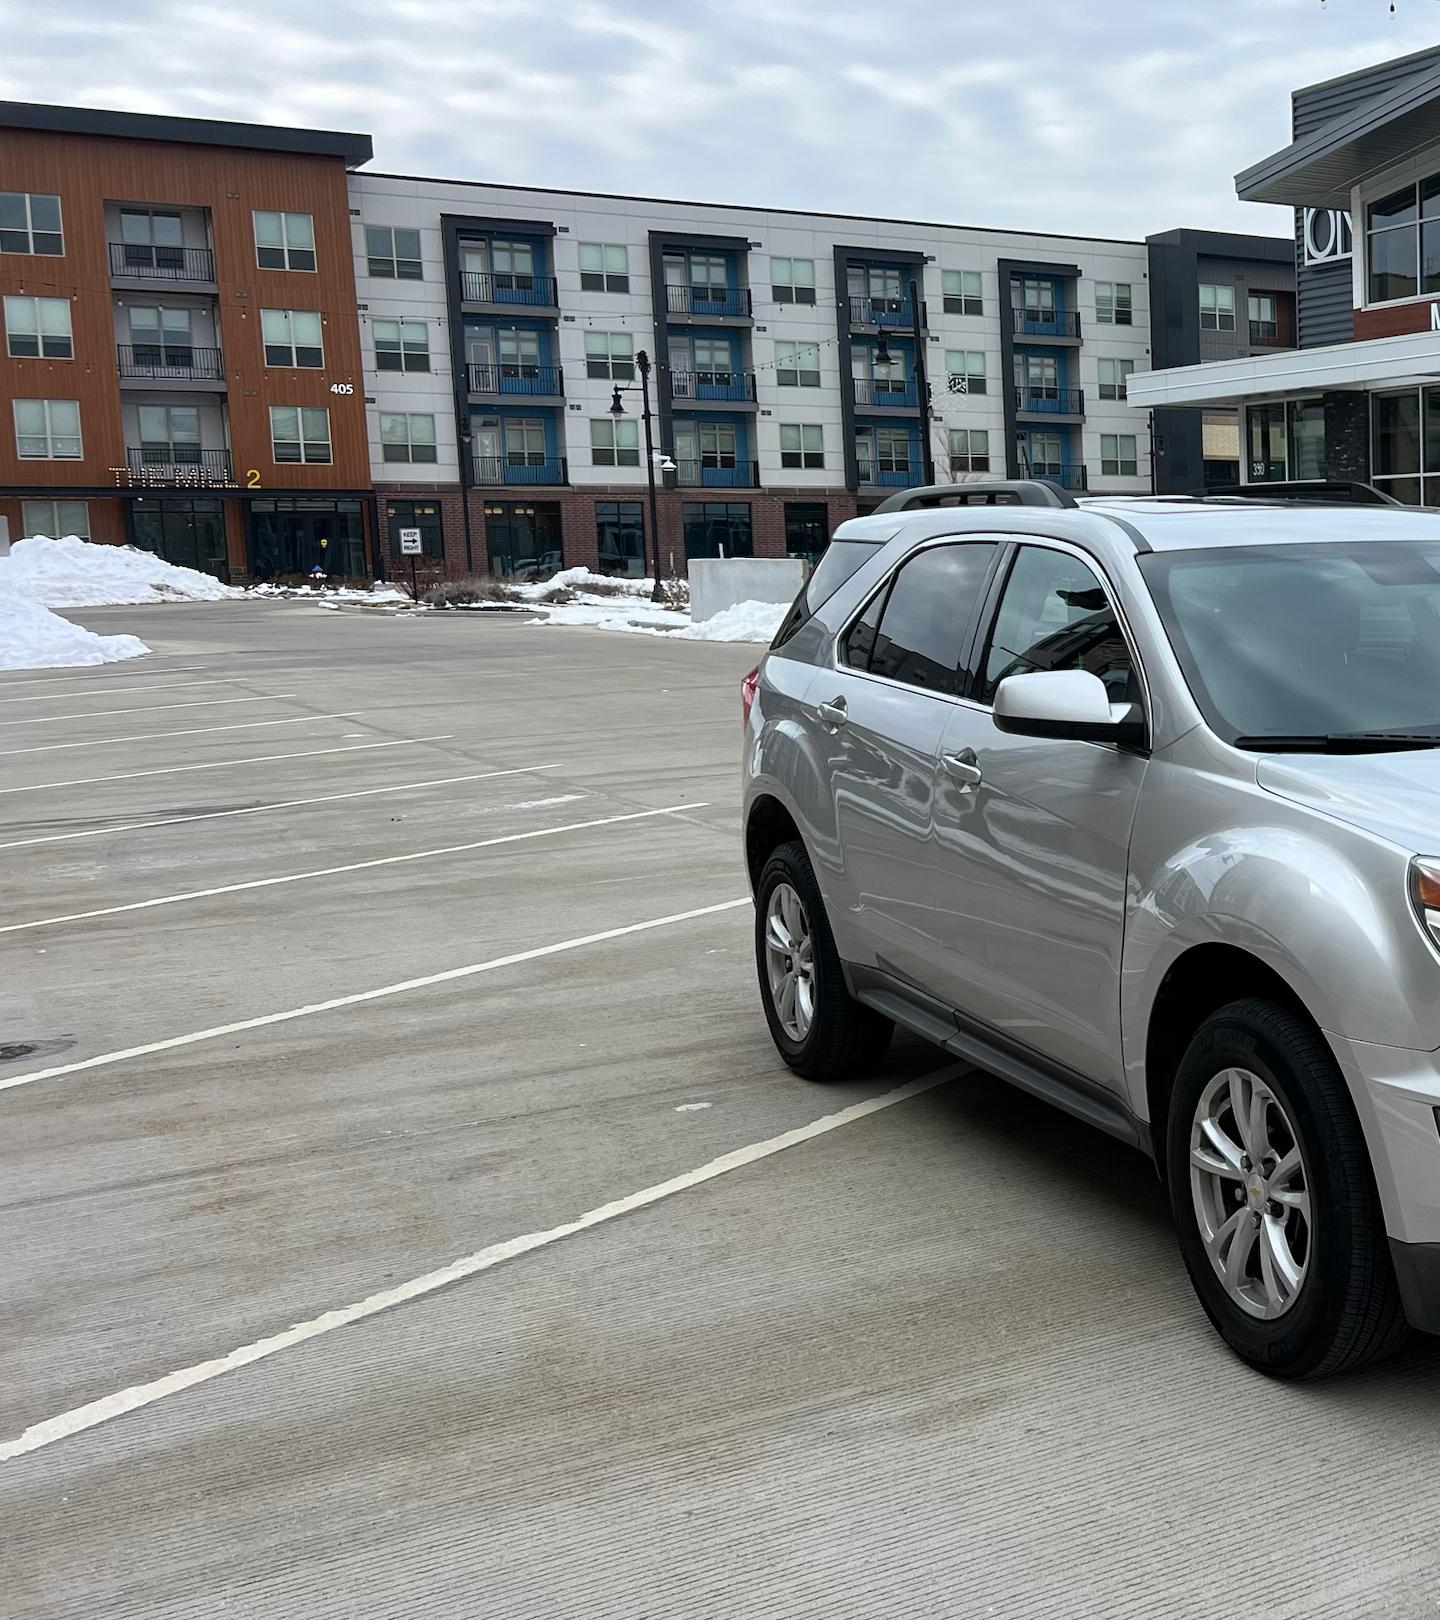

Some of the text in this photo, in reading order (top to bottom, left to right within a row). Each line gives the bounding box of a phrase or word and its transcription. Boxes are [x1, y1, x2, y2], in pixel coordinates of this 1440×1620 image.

[330, 383, 354, 395] 405
[108, 467, 262, 489] THE MILL 2
